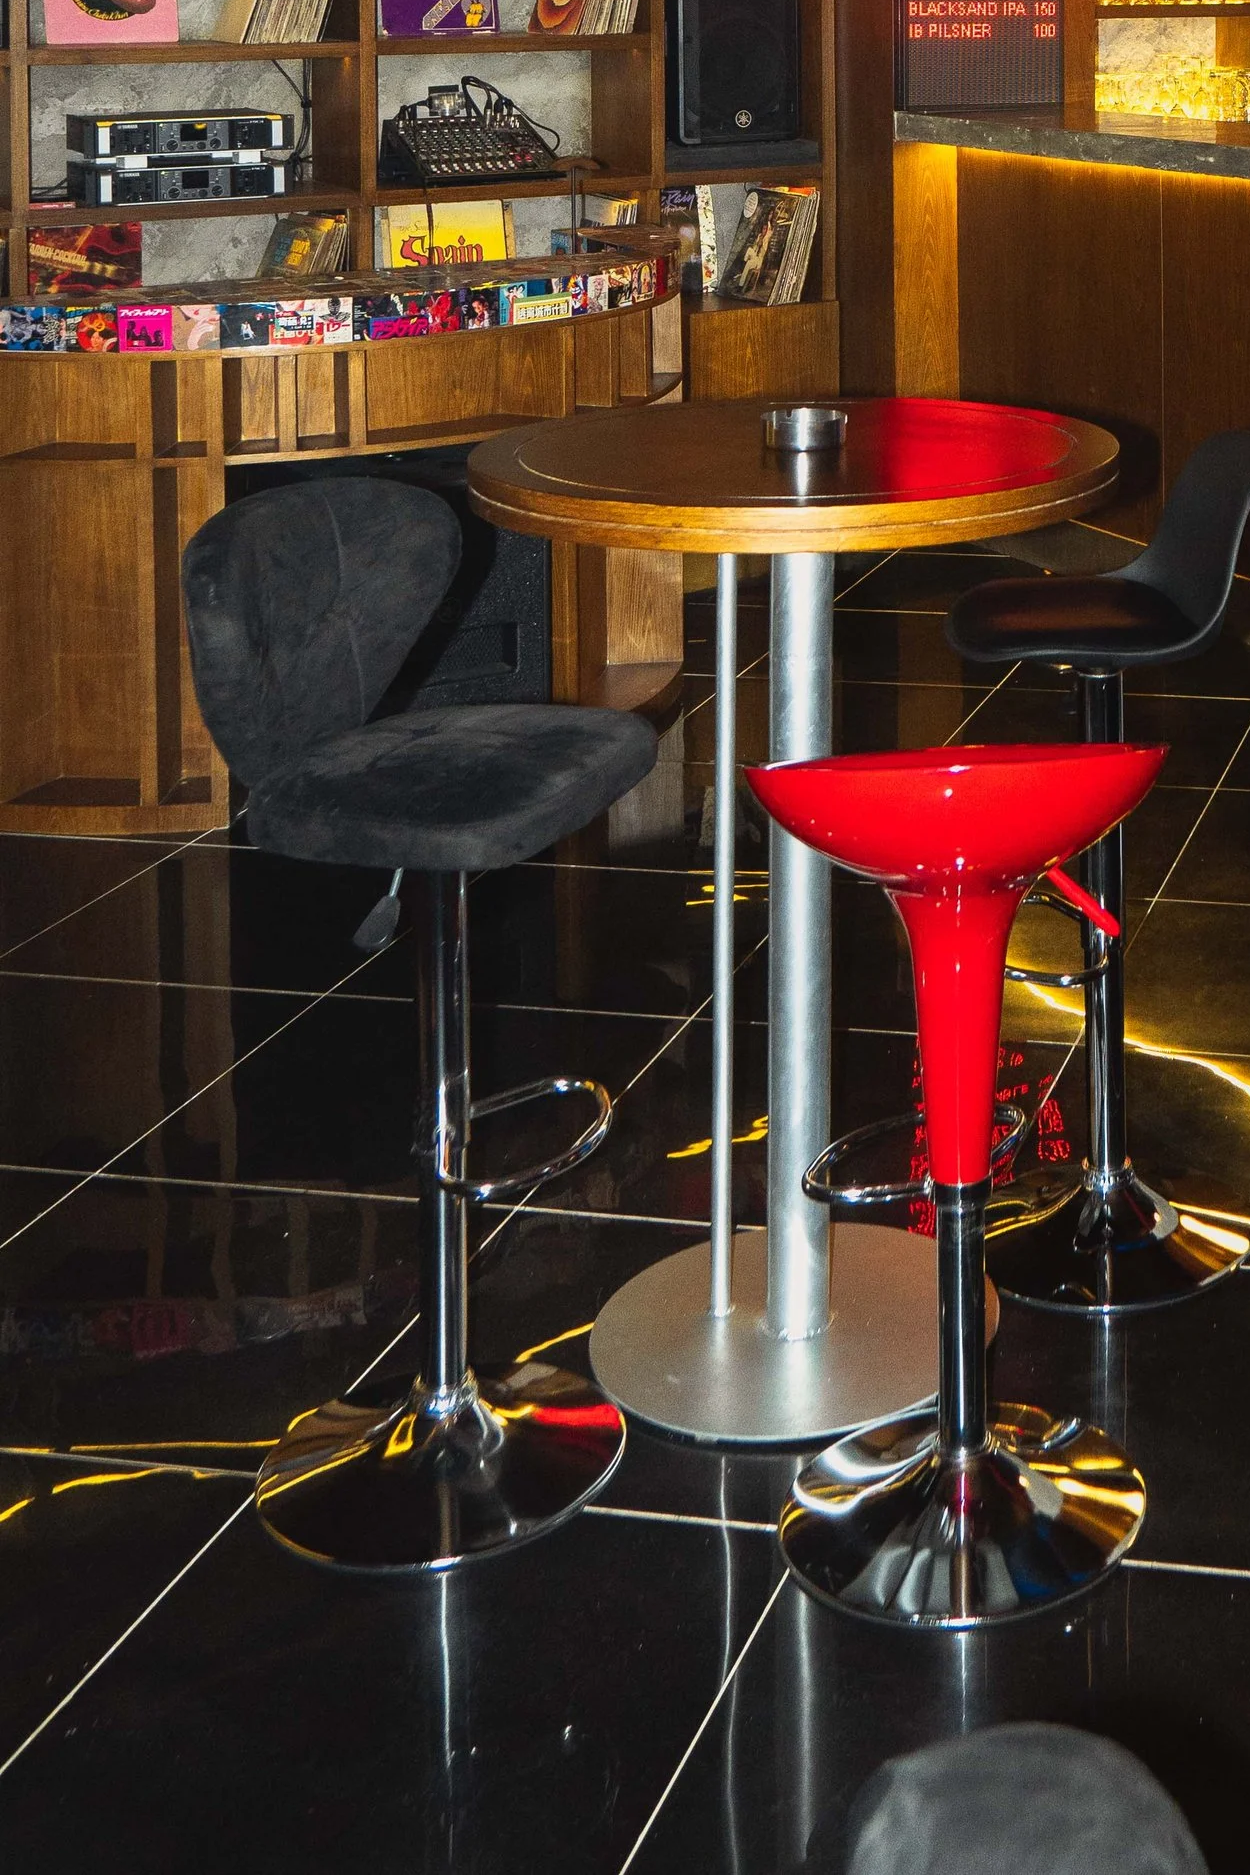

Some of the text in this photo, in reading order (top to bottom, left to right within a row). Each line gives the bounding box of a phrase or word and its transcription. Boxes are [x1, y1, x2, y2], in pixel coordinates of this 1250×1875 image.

[908, 1, 1027, 16] BLACKSAND IPA
[909, 24, 992, 39] IB PILSNER
[1034, 24, 1056, 38] 100
[400, 235, 484, 266] Spain
